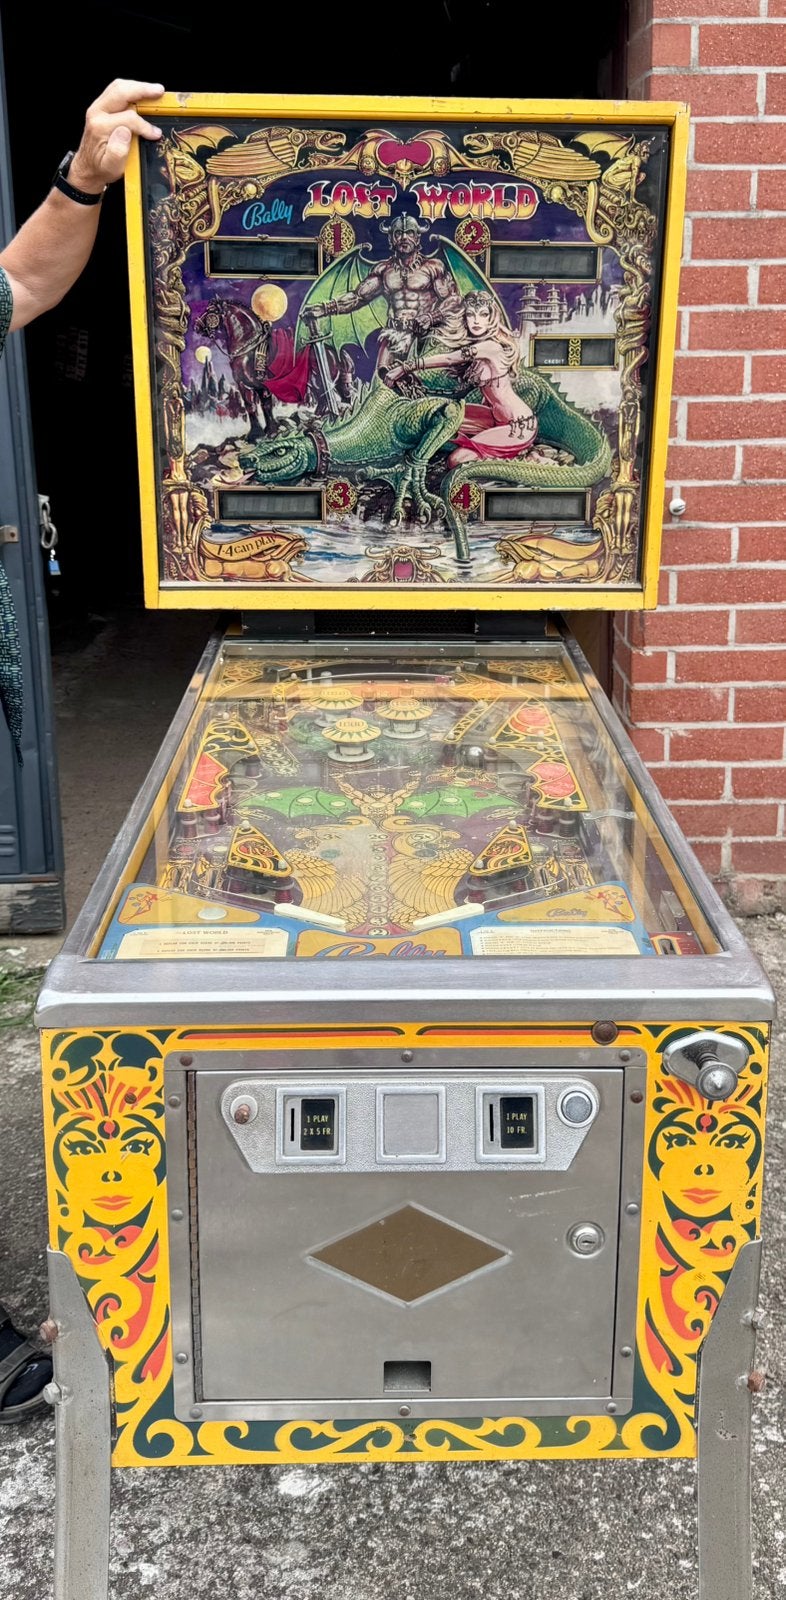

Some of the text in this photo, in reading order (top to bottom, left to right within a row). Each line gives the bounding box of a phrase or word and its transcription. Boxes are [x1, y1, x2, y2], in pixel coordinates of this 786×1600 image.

[242, 198, 293, 231] Bally
[302, 180, 540, 222] LOST WORLD
[331, 219, 344, 252] 1
[463, 218, 485, 252] 2
[330, 482, 350, 509] 3
[451, 483, 470, 512] 4
[234, 543, 254, 554] can
[313, 1115, 329, 1123] PLAY
[507, 1126, 515, 1134] 10
